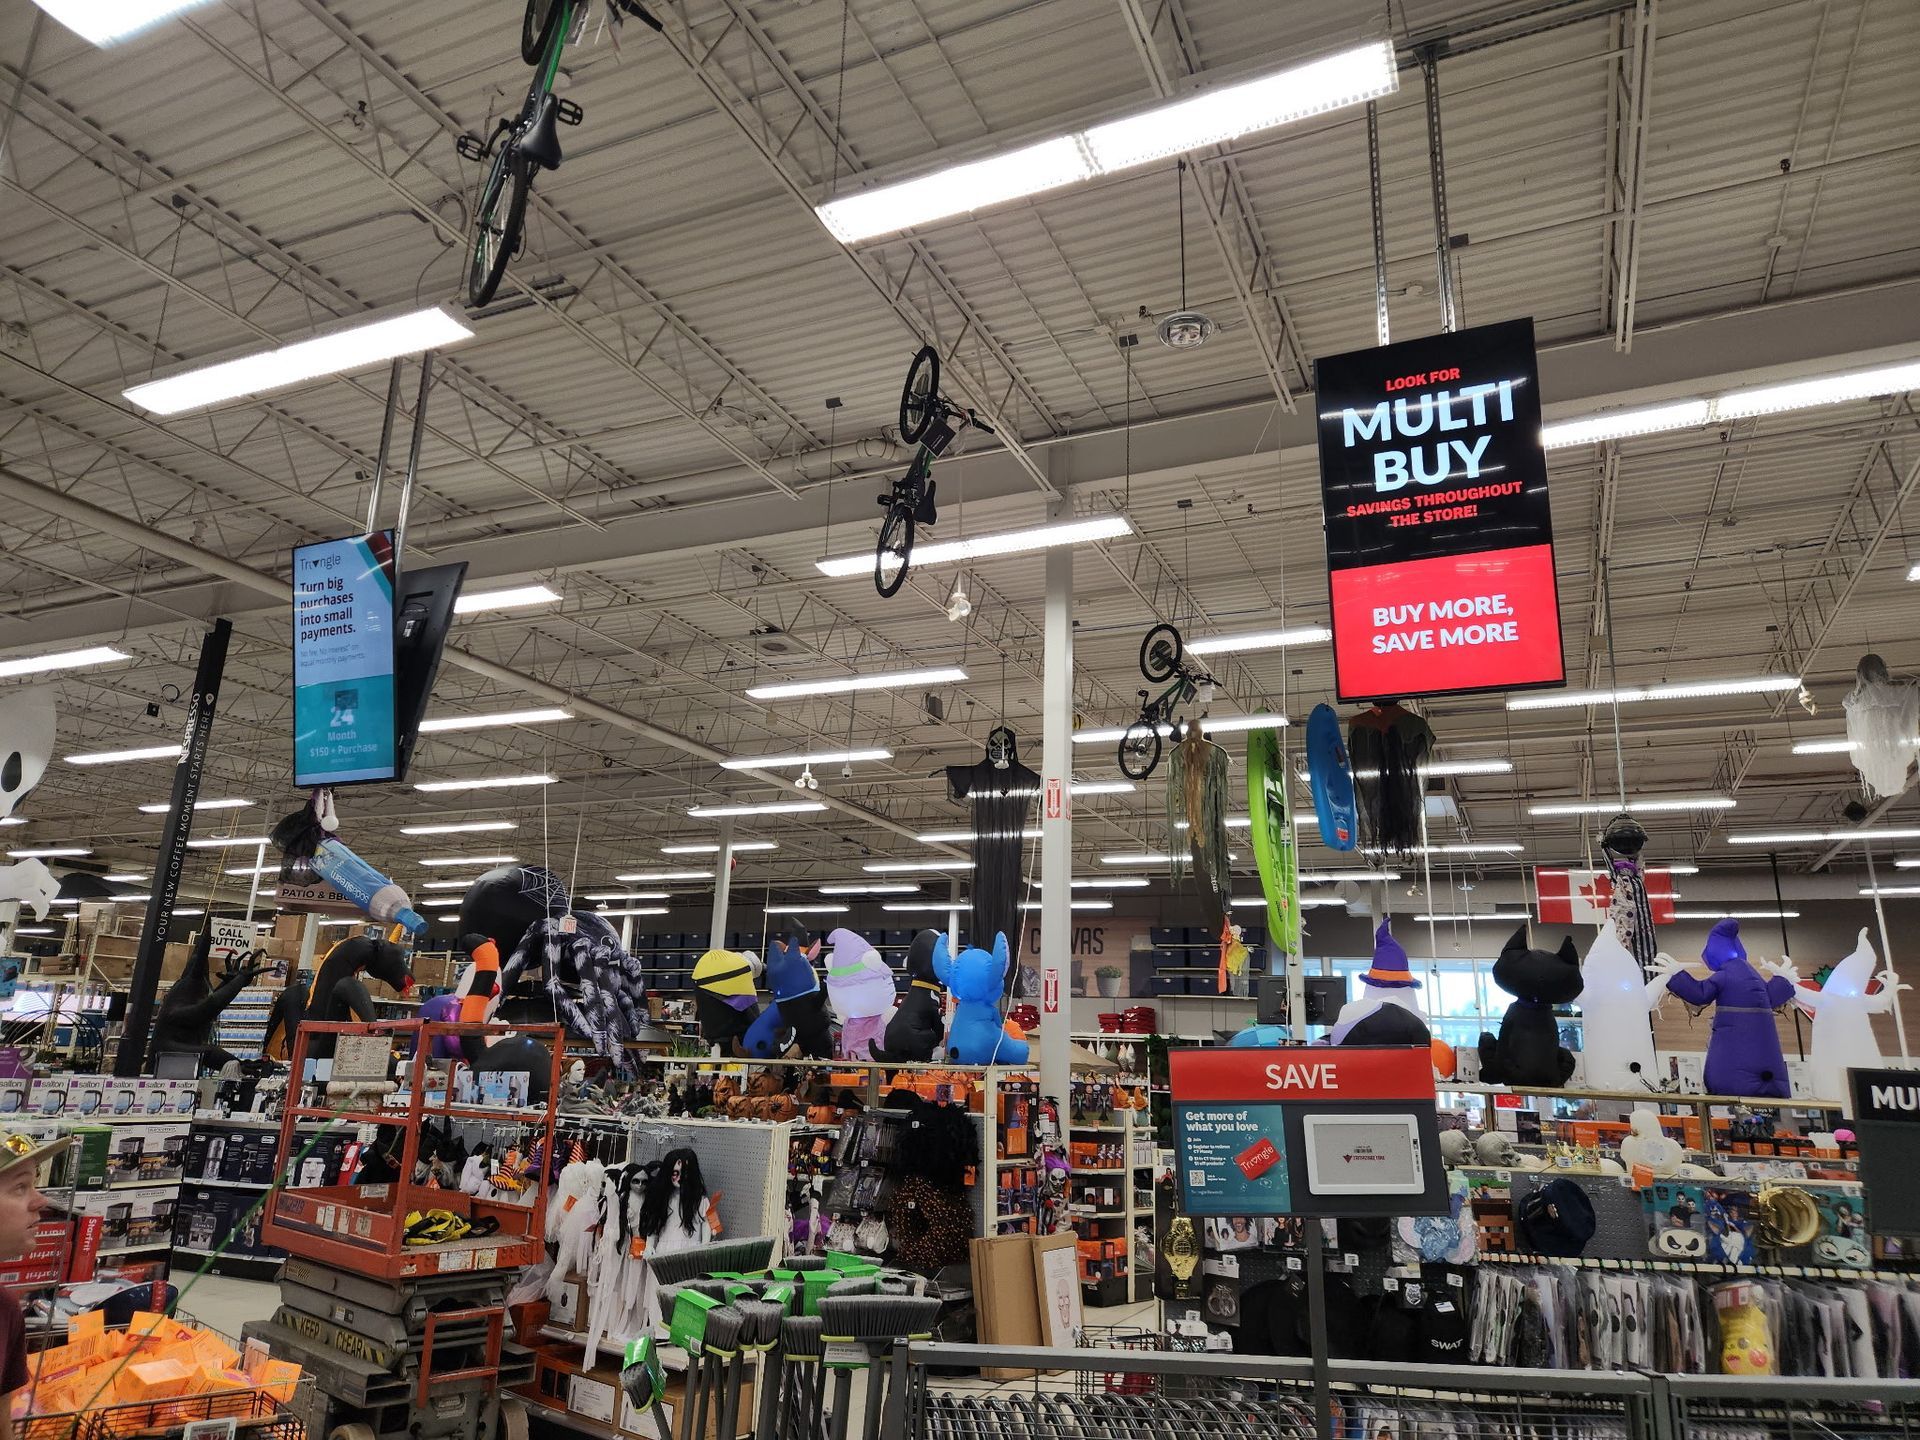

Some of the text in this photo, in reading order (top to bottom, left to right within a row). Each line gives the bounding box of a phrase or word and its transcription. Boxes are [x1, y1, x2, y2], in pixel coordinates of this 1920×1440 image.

[1386, 367, 1461, 391] LOOK FOR
[1343, 380, 1513, 447] MULTI
[1374, 435, 1492, 492] BUY
[1347, 481, 1523, 517] SAVINGS THROUGHOUT
[1390, 505, 1478, 528] THE STORE!
[300, 577, 344, 593] Turn big
[300, 592, 354, 610] purchases
[1373, 594, 1514, 627] BUY MORE,
[300, 607, 353, 626] into small
[301, 624, 356, 644] payments.
[1372, 621, 1519, 654] SAVE MORE
[330, 706, 354, 727] 24
[177, 693, 200, 767] NESPRESSO
[327, 729, 357, 742] Month
[310, 747, 329, 757] $150
[338, 743, 378, 755] Purchase
[155, 710, 211, 942] YOUR NEW COFFEE MOMENT STARTS HERE
[282, 888, 314, 899] PATIO
[318, 889, 327, 899] &
[330, 869, 370, 904] sodastream
[210, 937, 249, 948] BUTTON
[219, 928, 243, 938] CALL
[1030, 928, 1104, 955] CVAS
[41, 1080, 64, 1088] salton
[1265, 1063, 1339, 1090] SAVE
[1871, 1085, 1920, 1111] MU
[1186, 1111, 1248, 1121] Get more of
[1186, 1122, 1259, 1133] what you love
[299, 1317, 320, 1340] KEEP
[336, 1331, 367, 1361] CLEAR
[1431, 1338, 1463, 1350] SWAT
